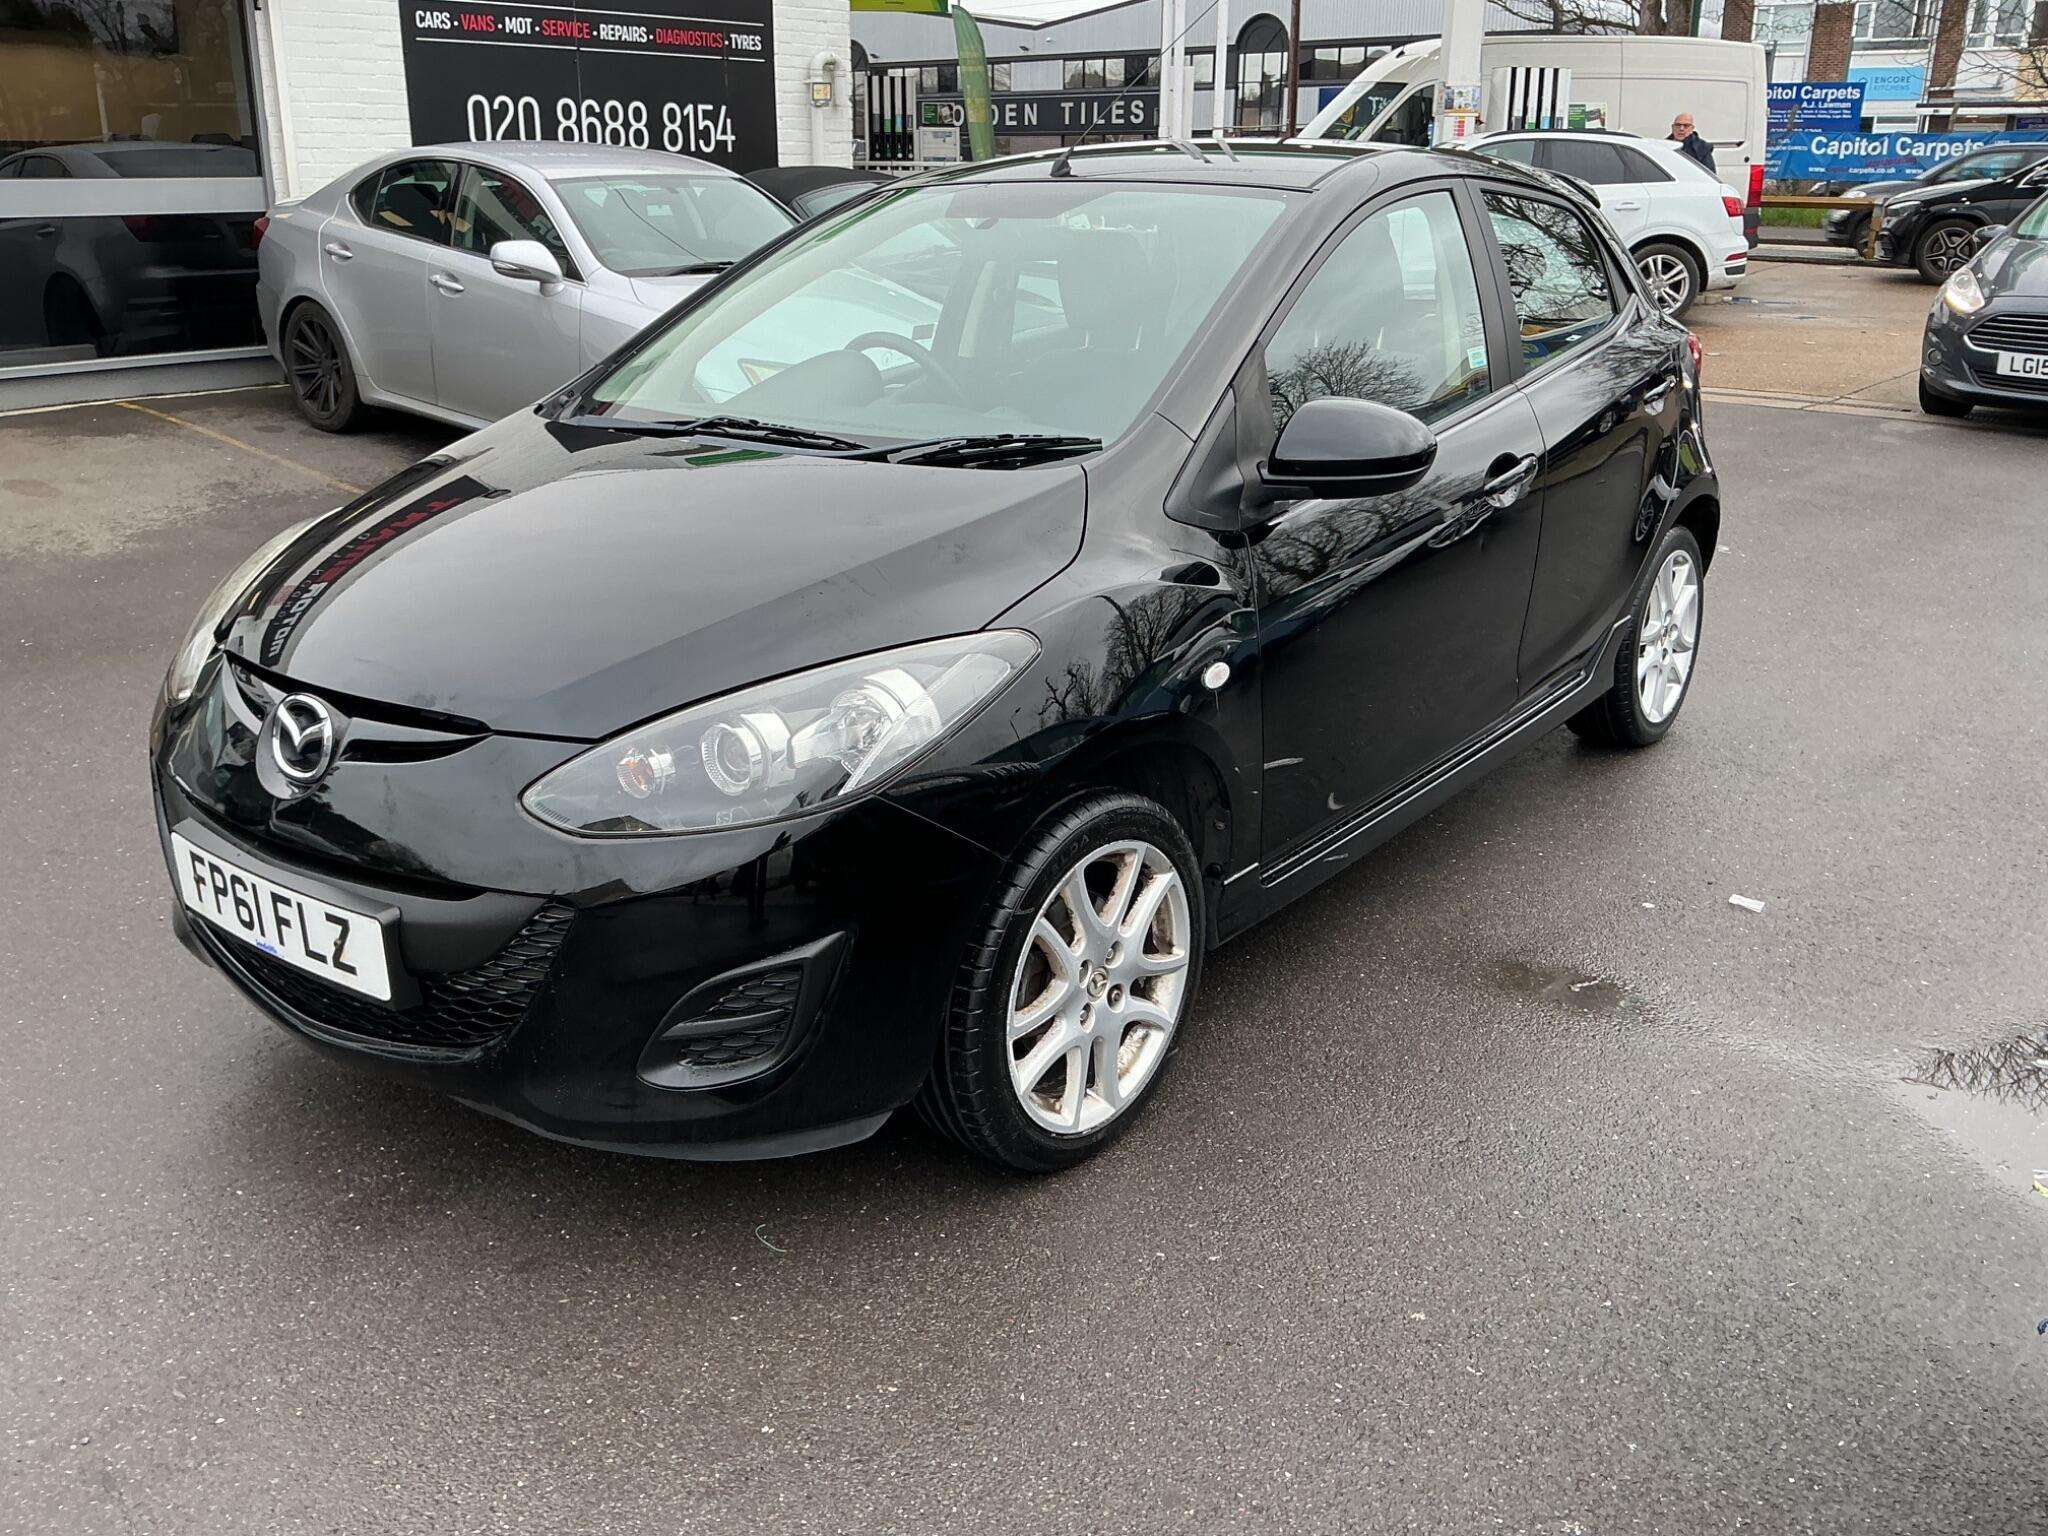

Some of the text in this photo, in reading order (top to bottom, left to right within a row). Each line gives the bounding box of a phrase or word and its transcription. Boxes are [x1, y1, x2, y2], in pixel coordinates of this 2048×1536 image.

[415, 10, 762, 51] CARS VANS MOT SERVICE REPAIRS DIAGNOSTICS TYRES
[1873, 76, 1912, 84] ENCORE
[1800, 85, 1861, 102] Carpets
[467, 94, 736, 153] 020 8688 8154
[1060, 100, 1145, 126] TILES
[1810, 136, 1889, 160] Capitol
[188, 850, 359, 977] FP61 FLZ
